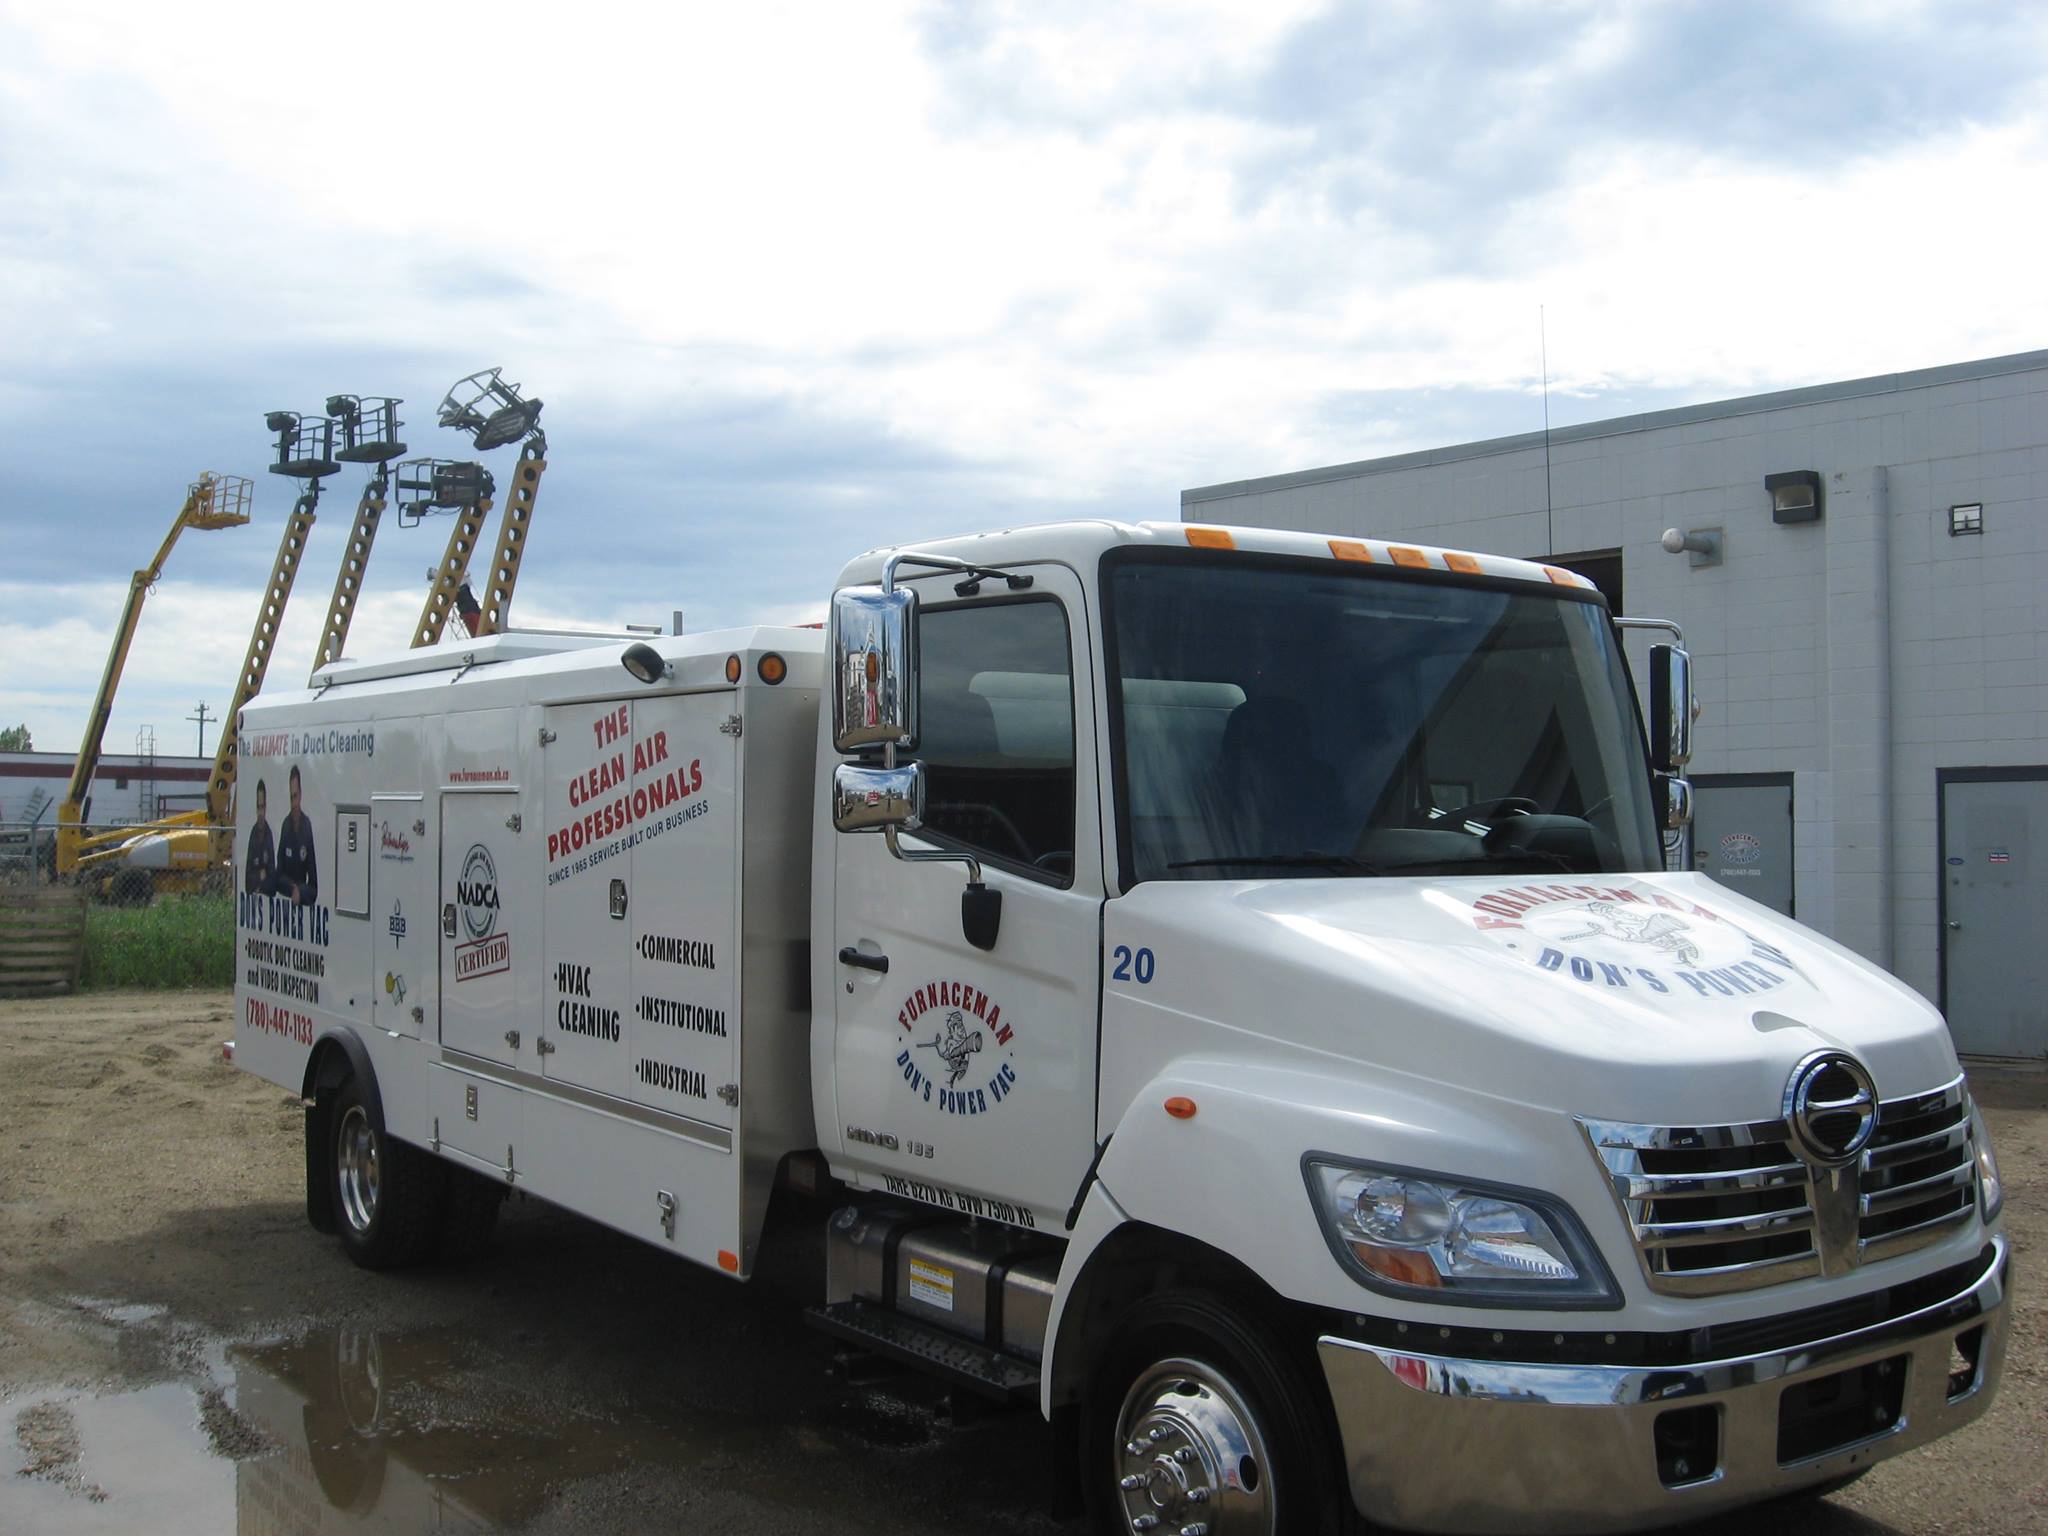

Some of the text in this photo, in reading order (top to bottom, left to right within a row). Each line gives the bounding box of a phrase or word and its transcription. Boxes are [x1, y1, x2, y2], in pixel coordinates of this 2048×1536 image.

[252, 734, 289, 757] ULTIMATE
[291, 734, 300, 755] in
[303, 731, 326, 755] Duct
[328, 729, 374, 757] Cleaning
[594, 704, 629, 749] THE
[569, 731, 669, 808] CLEAN AIR
[547, 759, 703, 862] PROFESSIONALS
[548, 866, 570, 886] SINCE
[588, 841, 620, 868] SERVICE
[621, 831, 645, 851] BUILT
[646, 821, 664, 840] OUR
[666, 800, 709, 830] BUSINESS
[457, 881, 500, 910] NADCA
[1473, 885, 1718, 931] FURNACEMAN
[269, 897, 304, 941] POWER
[310, 904, 329, 947] VAC
[389, 915, 406, 933] BBB
[248, 938, 325, 978] ROBOTIC DUCT CLEANING
[457, 941, 507, 975] CERTIFIED
[642, 934, 715, 969] COMMERCIAL
[1113, 945, 1155, 984] 20
[1536, 947, 1669, 994] DON'S
[1674, 960, 1785, 996] POWER
[248, 965, 319, 1004] and VIDEO INSPECTION
[558, 963, 591, 998] HVAC
[246, 997, 313, 1046] (780)-447-1133
[558, 1000, 620, 1043] CLEANING
[641, 996, 727, 1037] INSTITUTIONAL
[898, 981, 1014, 1047] FURNACEMAN
[641, 1058, 707, 1100] INDUSTRIAL
[897, 1050, 1016, 1115] DON'S POWER VAC
[882, 1173, 1035, 1228] TARE 6270 KG GVW 7500 KG
